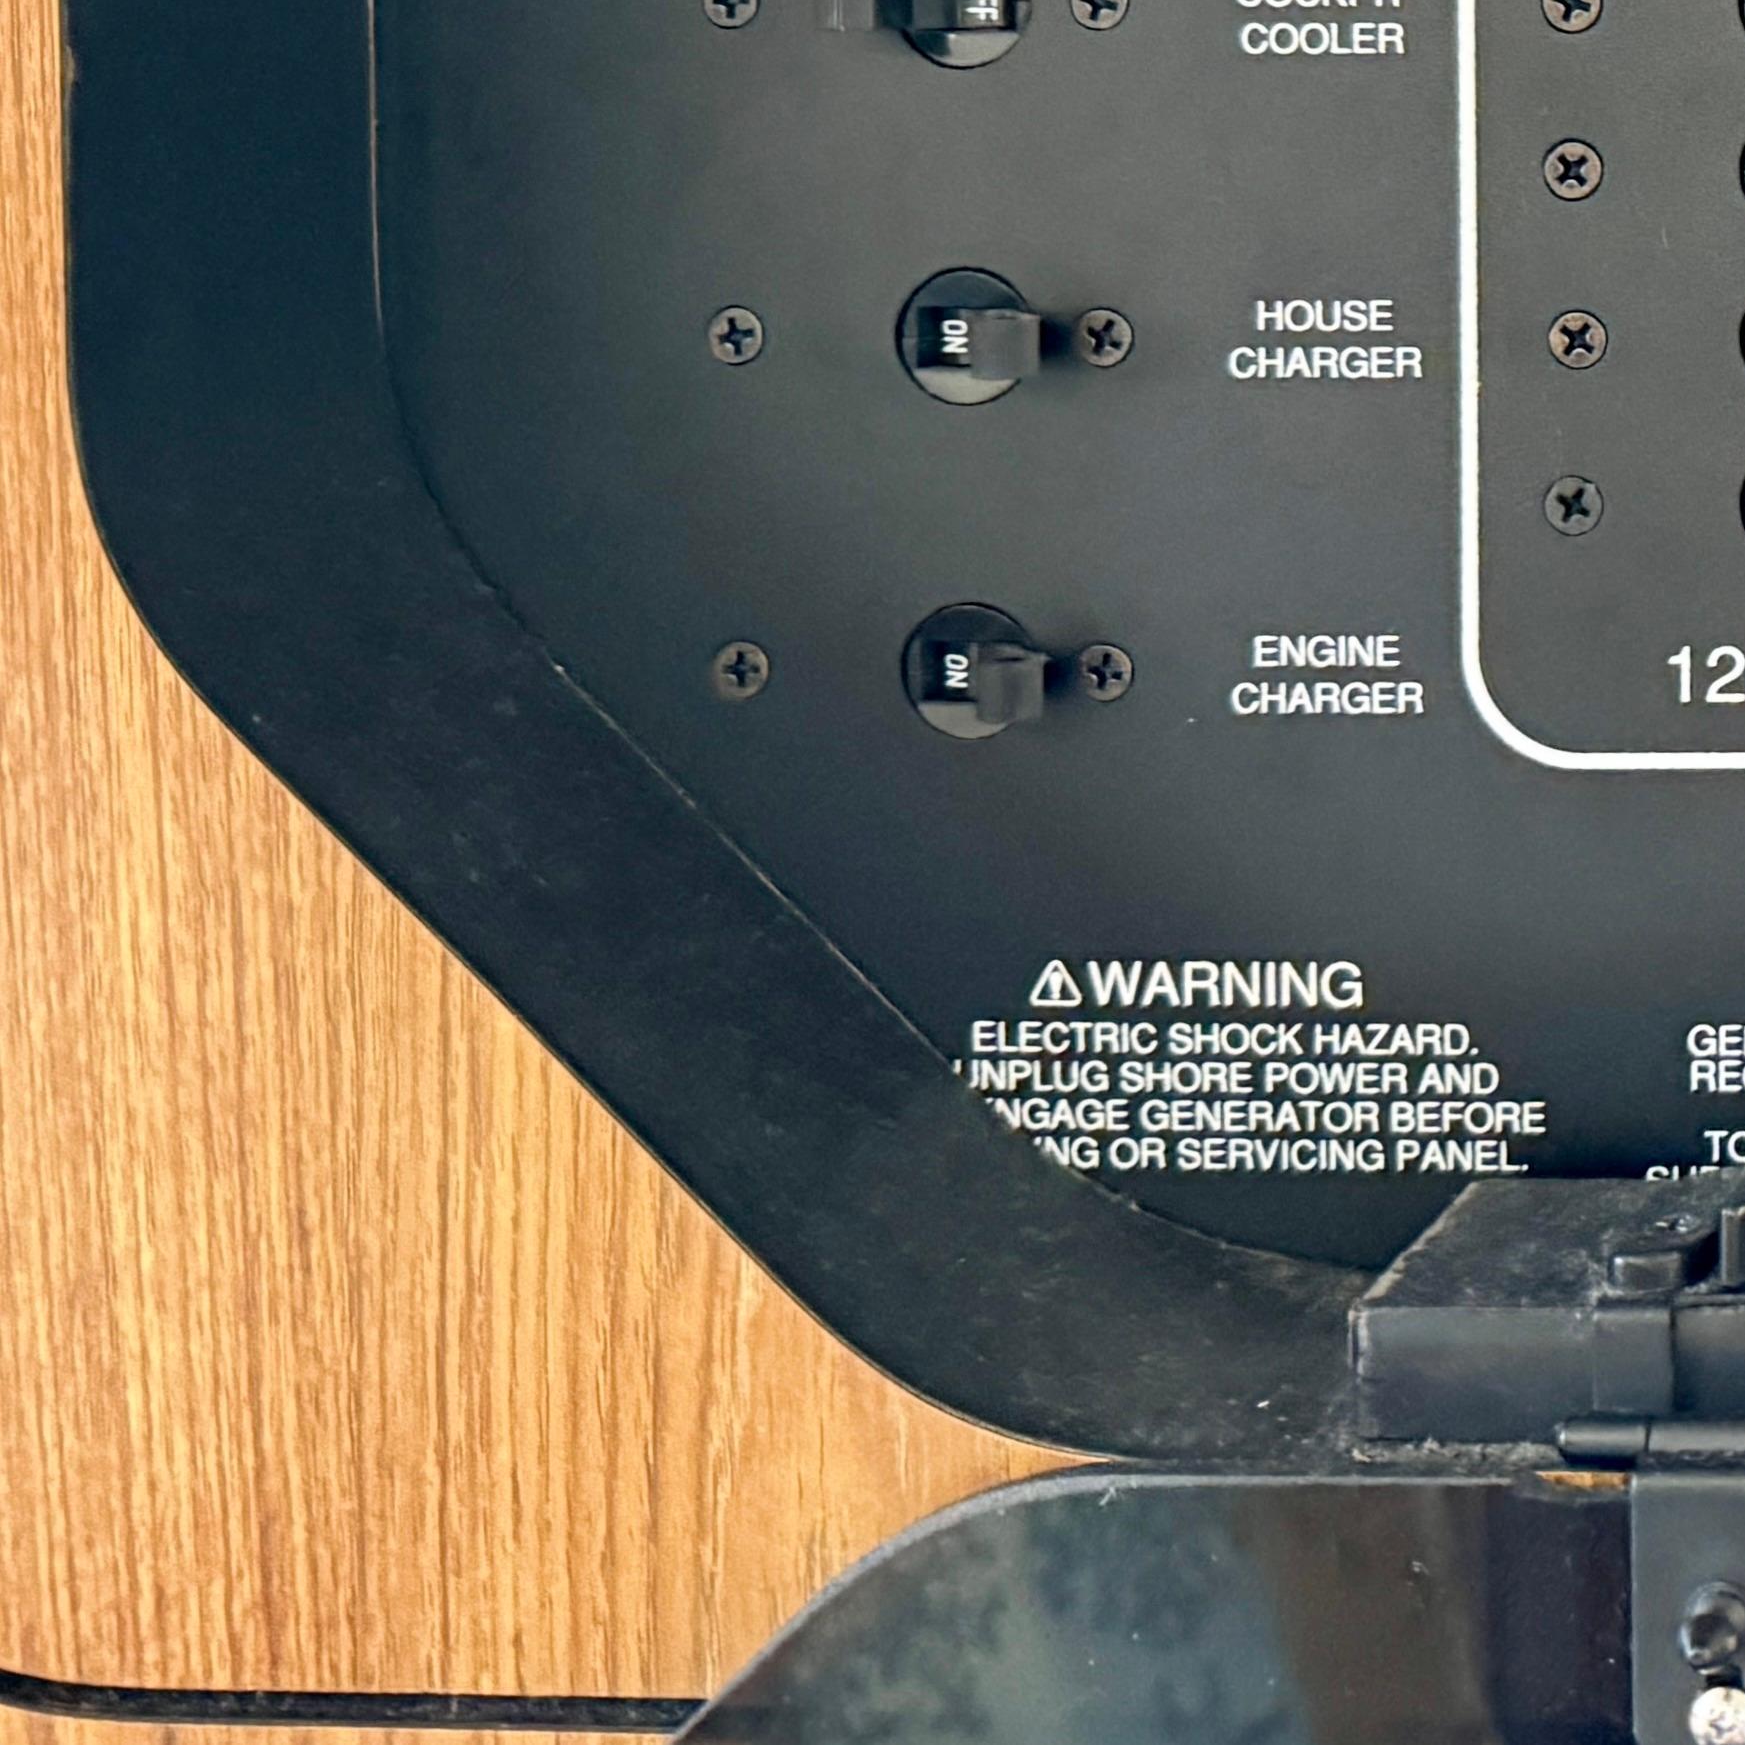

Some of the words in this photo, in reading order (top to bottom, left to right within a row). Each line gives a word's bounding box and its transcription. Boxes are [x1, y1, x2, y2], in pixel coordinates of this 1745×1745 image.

[1239, 22, 1405, 55] COOLER
[1256, 299, 1394, 332] HOUSE
[942, 320, 968, 355] ON
[1228, 346, 1423, 379] CHARGER
[1253, 634, 1401, 668] ENGINE
[945, 654, 970, 689] ON
[1230, 681, 1424, 715] CHARGER
[1087, 960, 1364, 1010] WARNING
[971, 1020, 1159, 1055] ELECTRIC
[1168, 1022, 1304, 1057] SHOCK
[1313, 1023, 1479, 1057] HAZARD.
[1119, 1060, 1254, 1094] SHORE
[1264, 1061, 1408, 1095] POWER
[1417, 1062, 1500, 1095] AND
[1139, 1099, 1380, 1134] GENERATOR
[1390, 1100, 1546, 1135] BEFORE
[1108, 1136, 1167, 1170] OR
[1176, 1137, 1385, 1173] SERVICING
[1395, 1139, 1529, 1172] PANEL.
